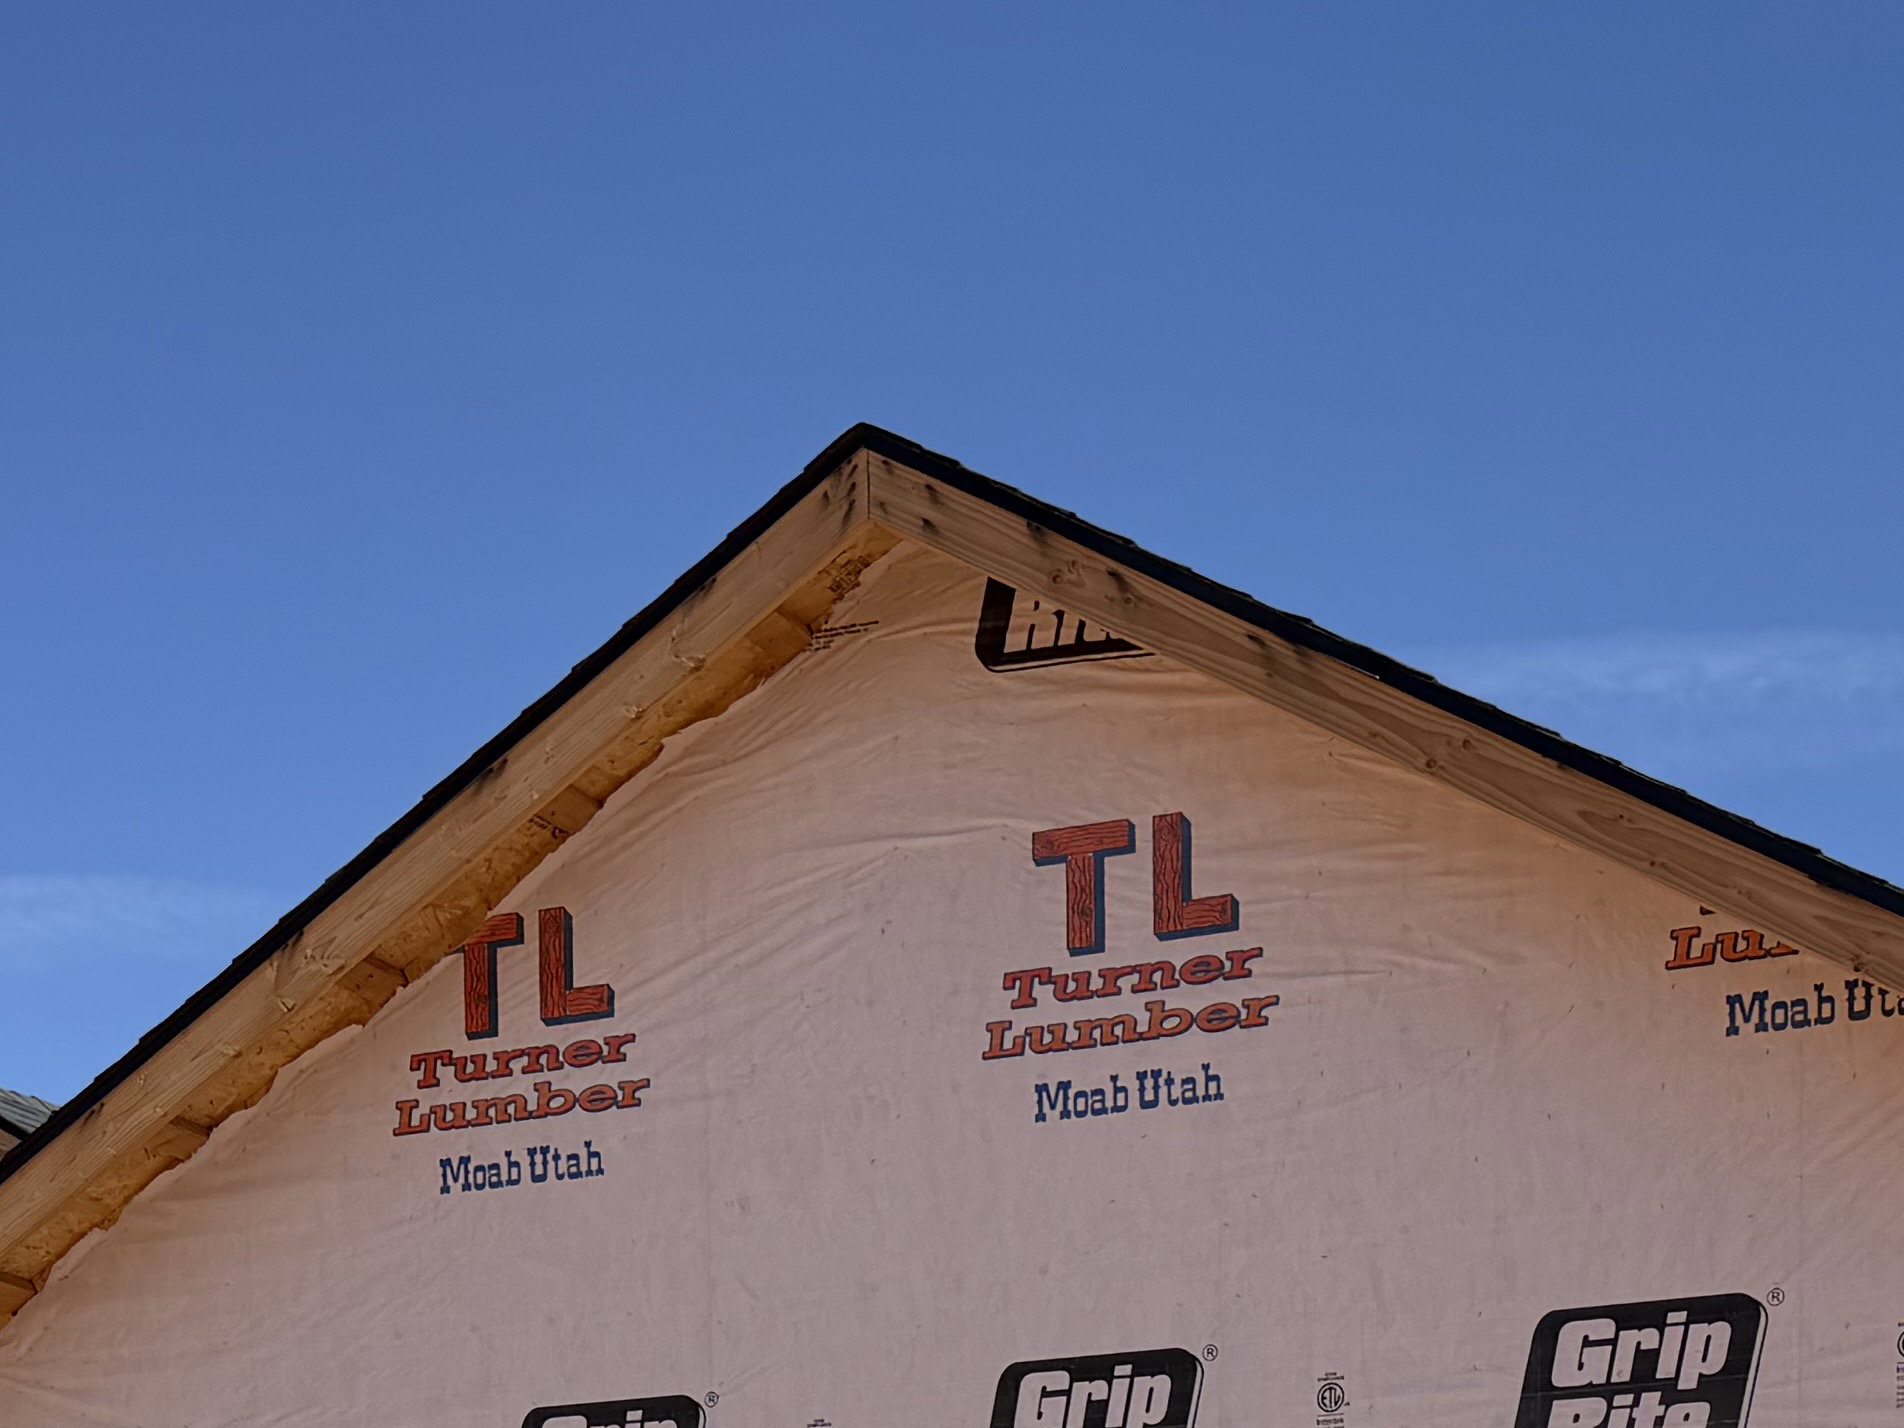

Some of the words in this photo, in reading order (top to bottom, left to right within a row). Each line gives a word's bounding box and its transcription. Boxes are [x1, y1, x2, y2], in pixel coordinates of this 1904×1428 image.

[1032, 811, 1240, 957] TL
[450, 906, 615, 1041] TL
[1003, 947, 1263, 1009] Turner
[982, 995, 1280, 1060] Lumber
[1725, 982, 1836, 1038] Moab
[409, 1033, 636, 1089] Turner
[393, 1078, 651, 1136] Lumber
[1034, 1074, 1129, 1123] Moab
[1136, 1062, 1225, 1110] Utah
[439, 1150, 522, 1195] Moab
[526, 1140, 605, 1184] Utah
[1551, 1310, 1732, 1390] Grip
